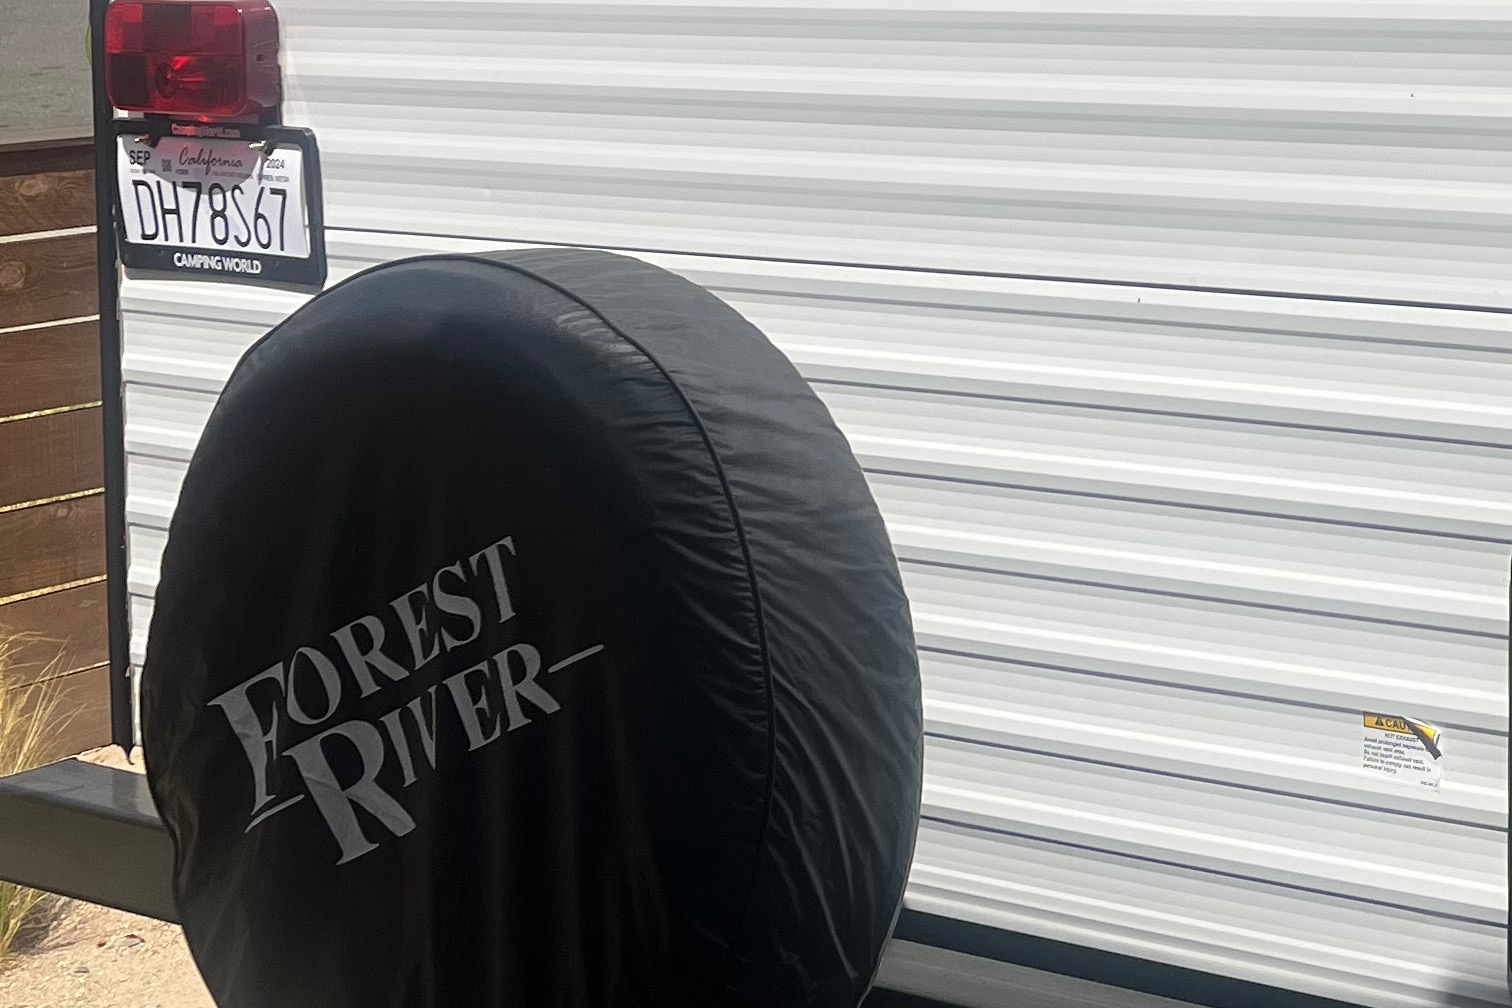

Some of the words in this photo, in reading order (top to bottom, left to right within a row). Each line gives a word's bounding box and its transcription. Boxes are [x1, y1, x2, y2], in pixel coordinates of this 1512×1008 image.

[129, 149, 151, 165] SEP
[178, 146, 243, 175] California
[132, 179, 288, 252] DH78S67
[173, 252, 220, 270] CAMPING
[220, 256, 262, 274] WORLD
[207, 535, 518, 816] FOREST
[280, 643, 562, 867] RIVER
